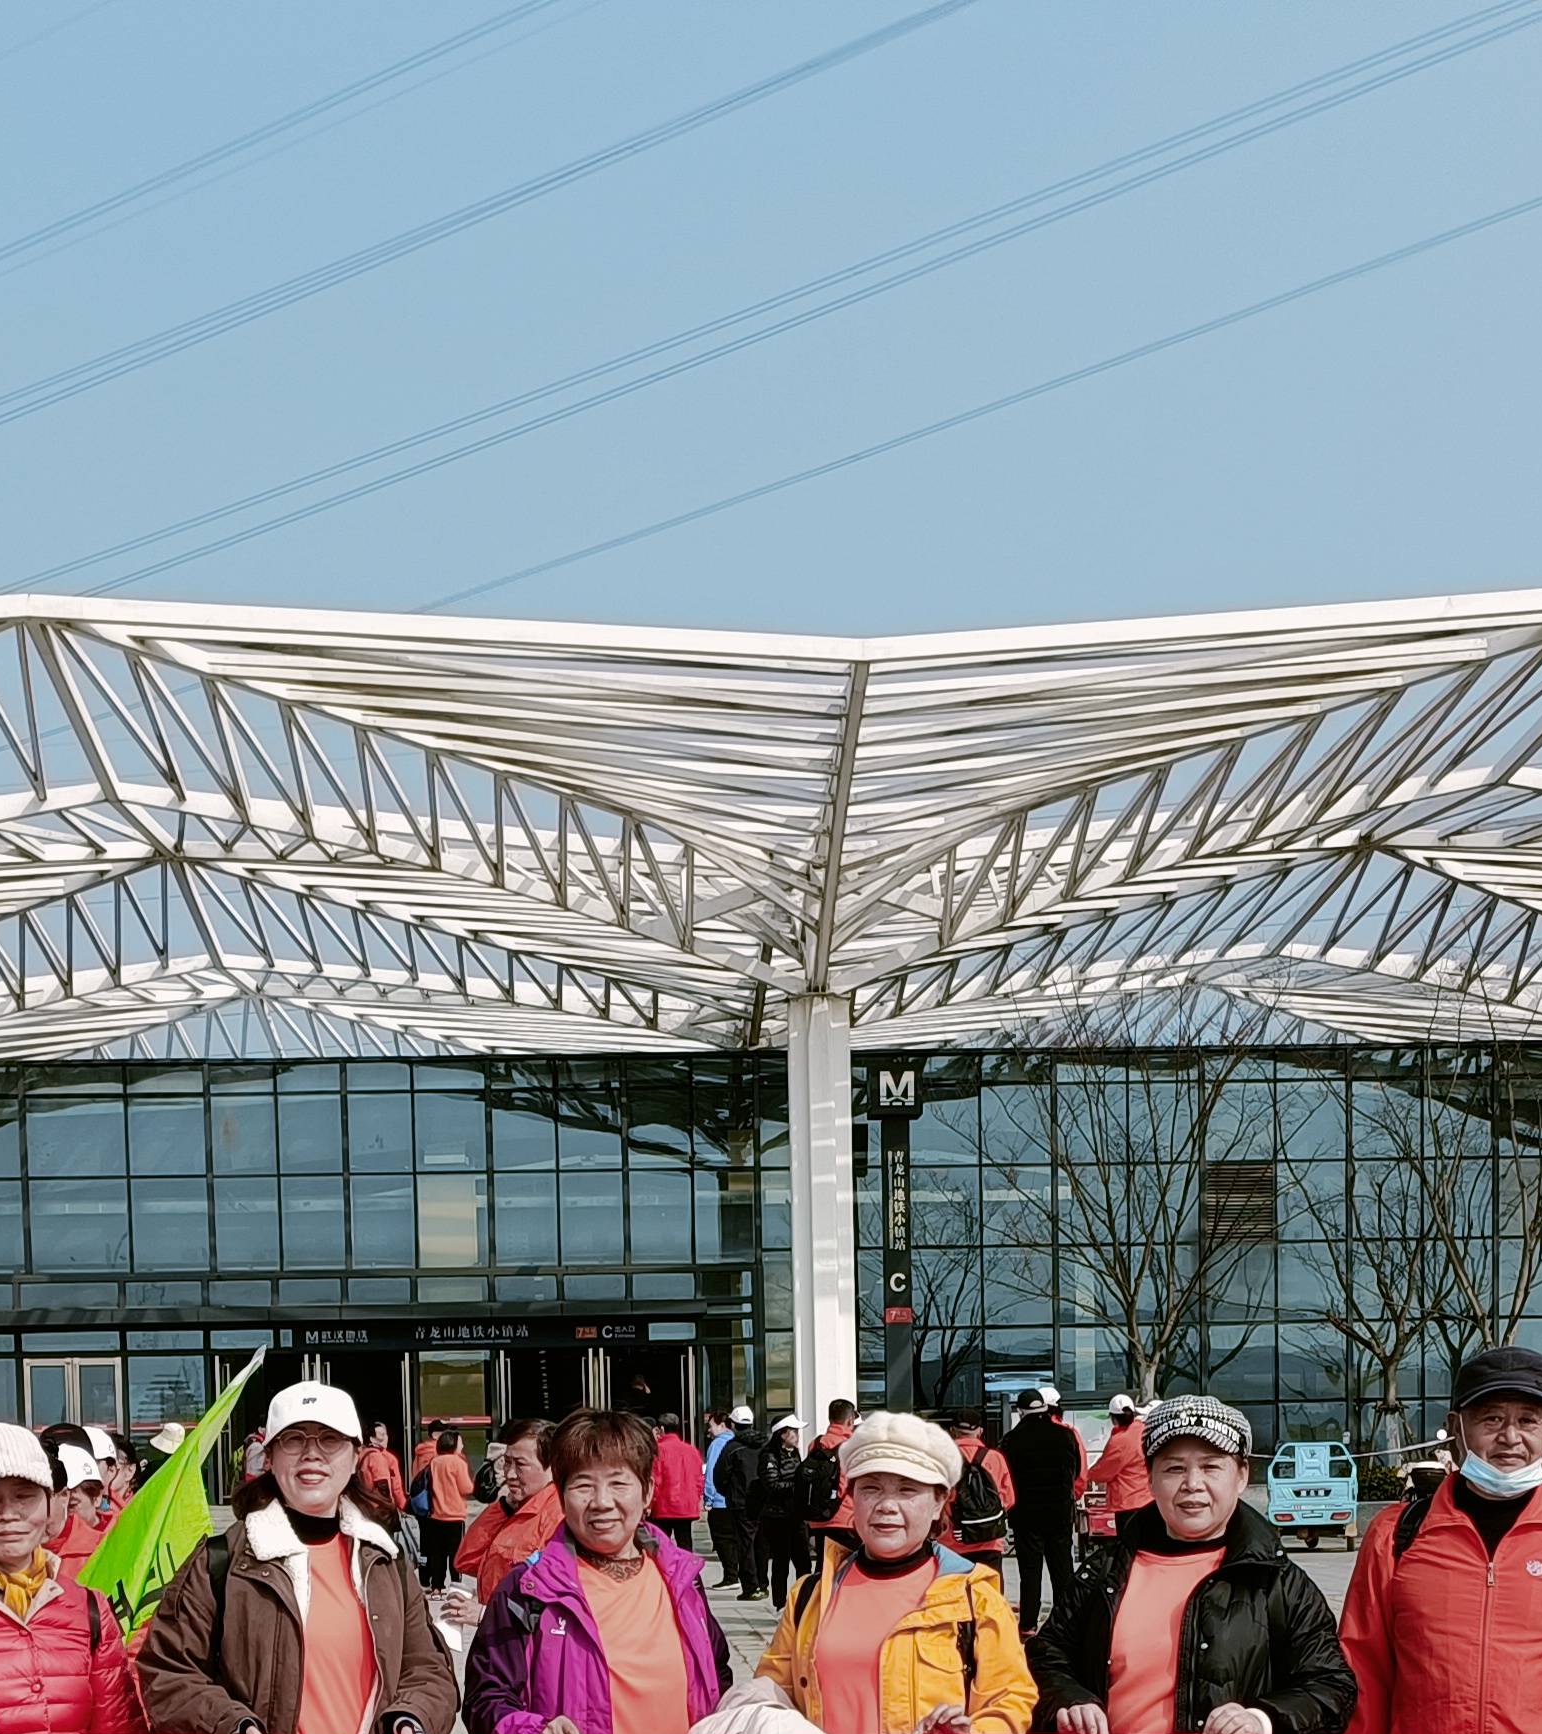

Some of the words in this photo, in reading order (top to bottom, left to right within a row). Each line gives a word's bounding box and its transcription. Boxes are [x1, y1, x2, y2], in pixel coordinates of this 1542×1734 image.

[880, 1071, 915, 1106] M
[889, 1272, 906, 1292] C
[415, 1325, 529, 1339] 青龙山地铁小镇站
[602, 1325, 613, 1338] C
